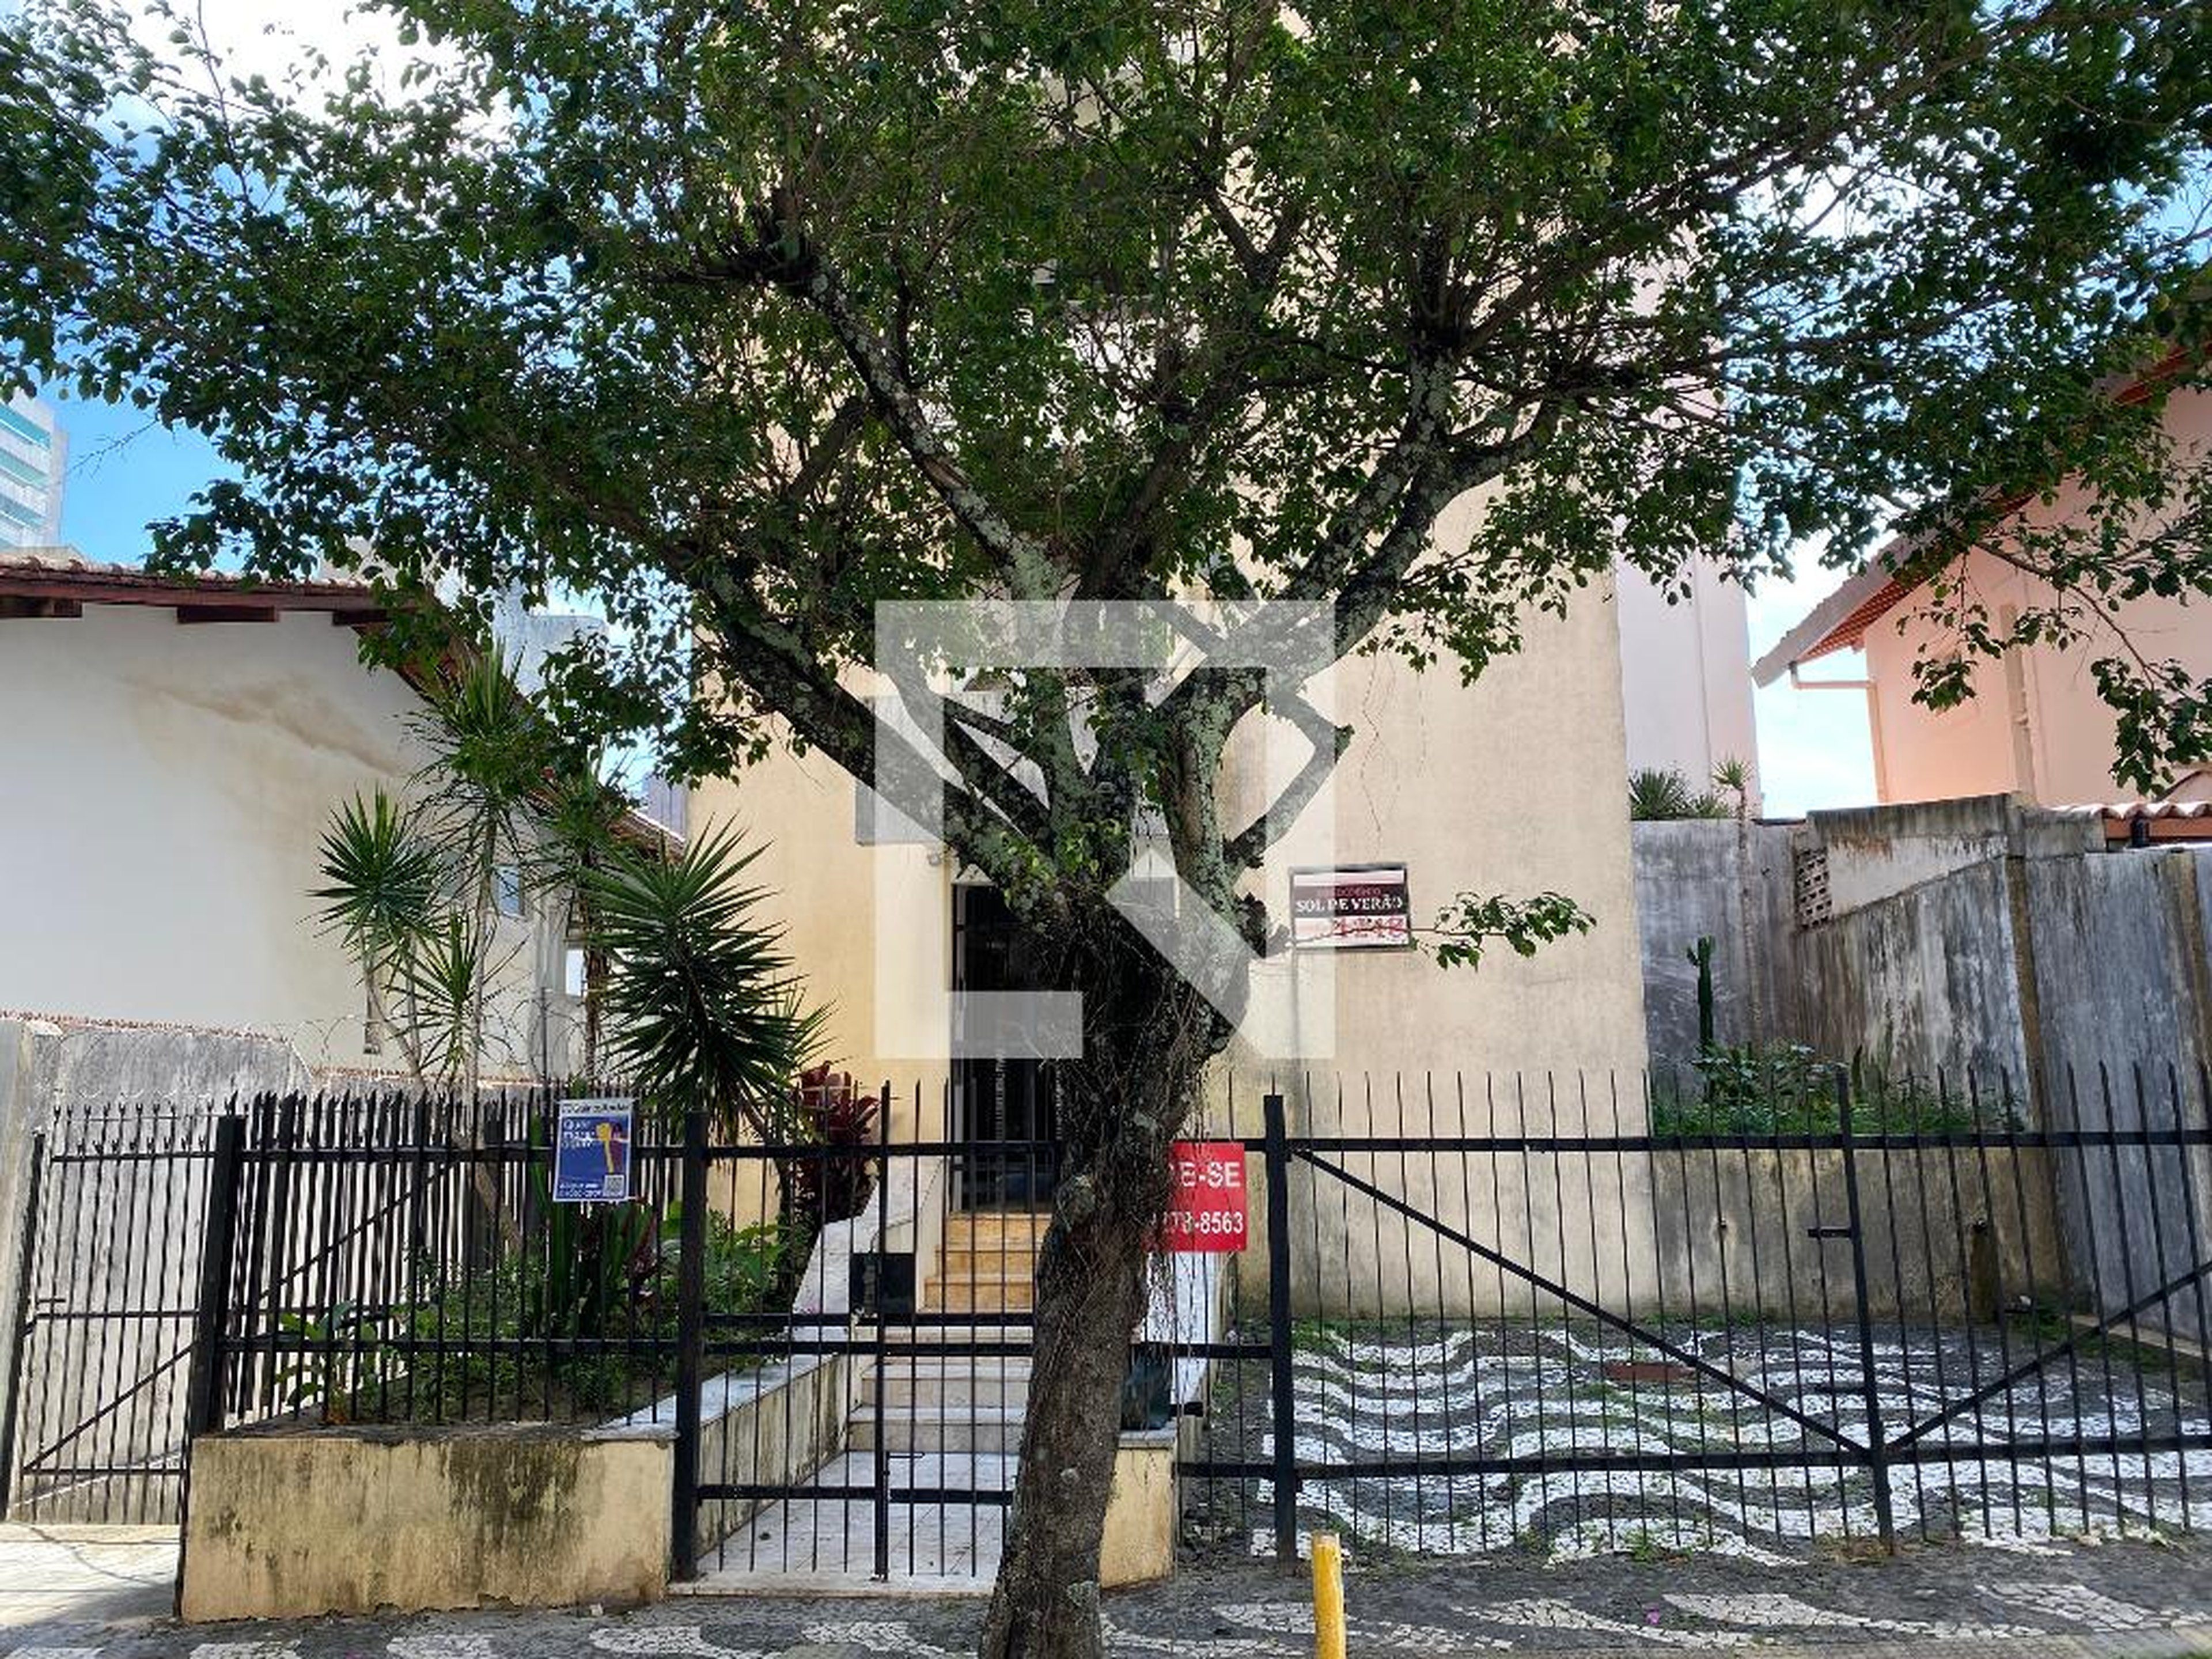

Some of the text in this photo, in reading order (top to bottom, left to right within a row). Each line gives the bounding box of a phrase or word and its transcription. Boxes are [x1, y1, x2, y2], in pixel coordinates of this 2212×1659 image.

[1296, 895, 1403, 912] SOL DE VERÃO
[1169, 1161, 1241, 1188] E-SE
